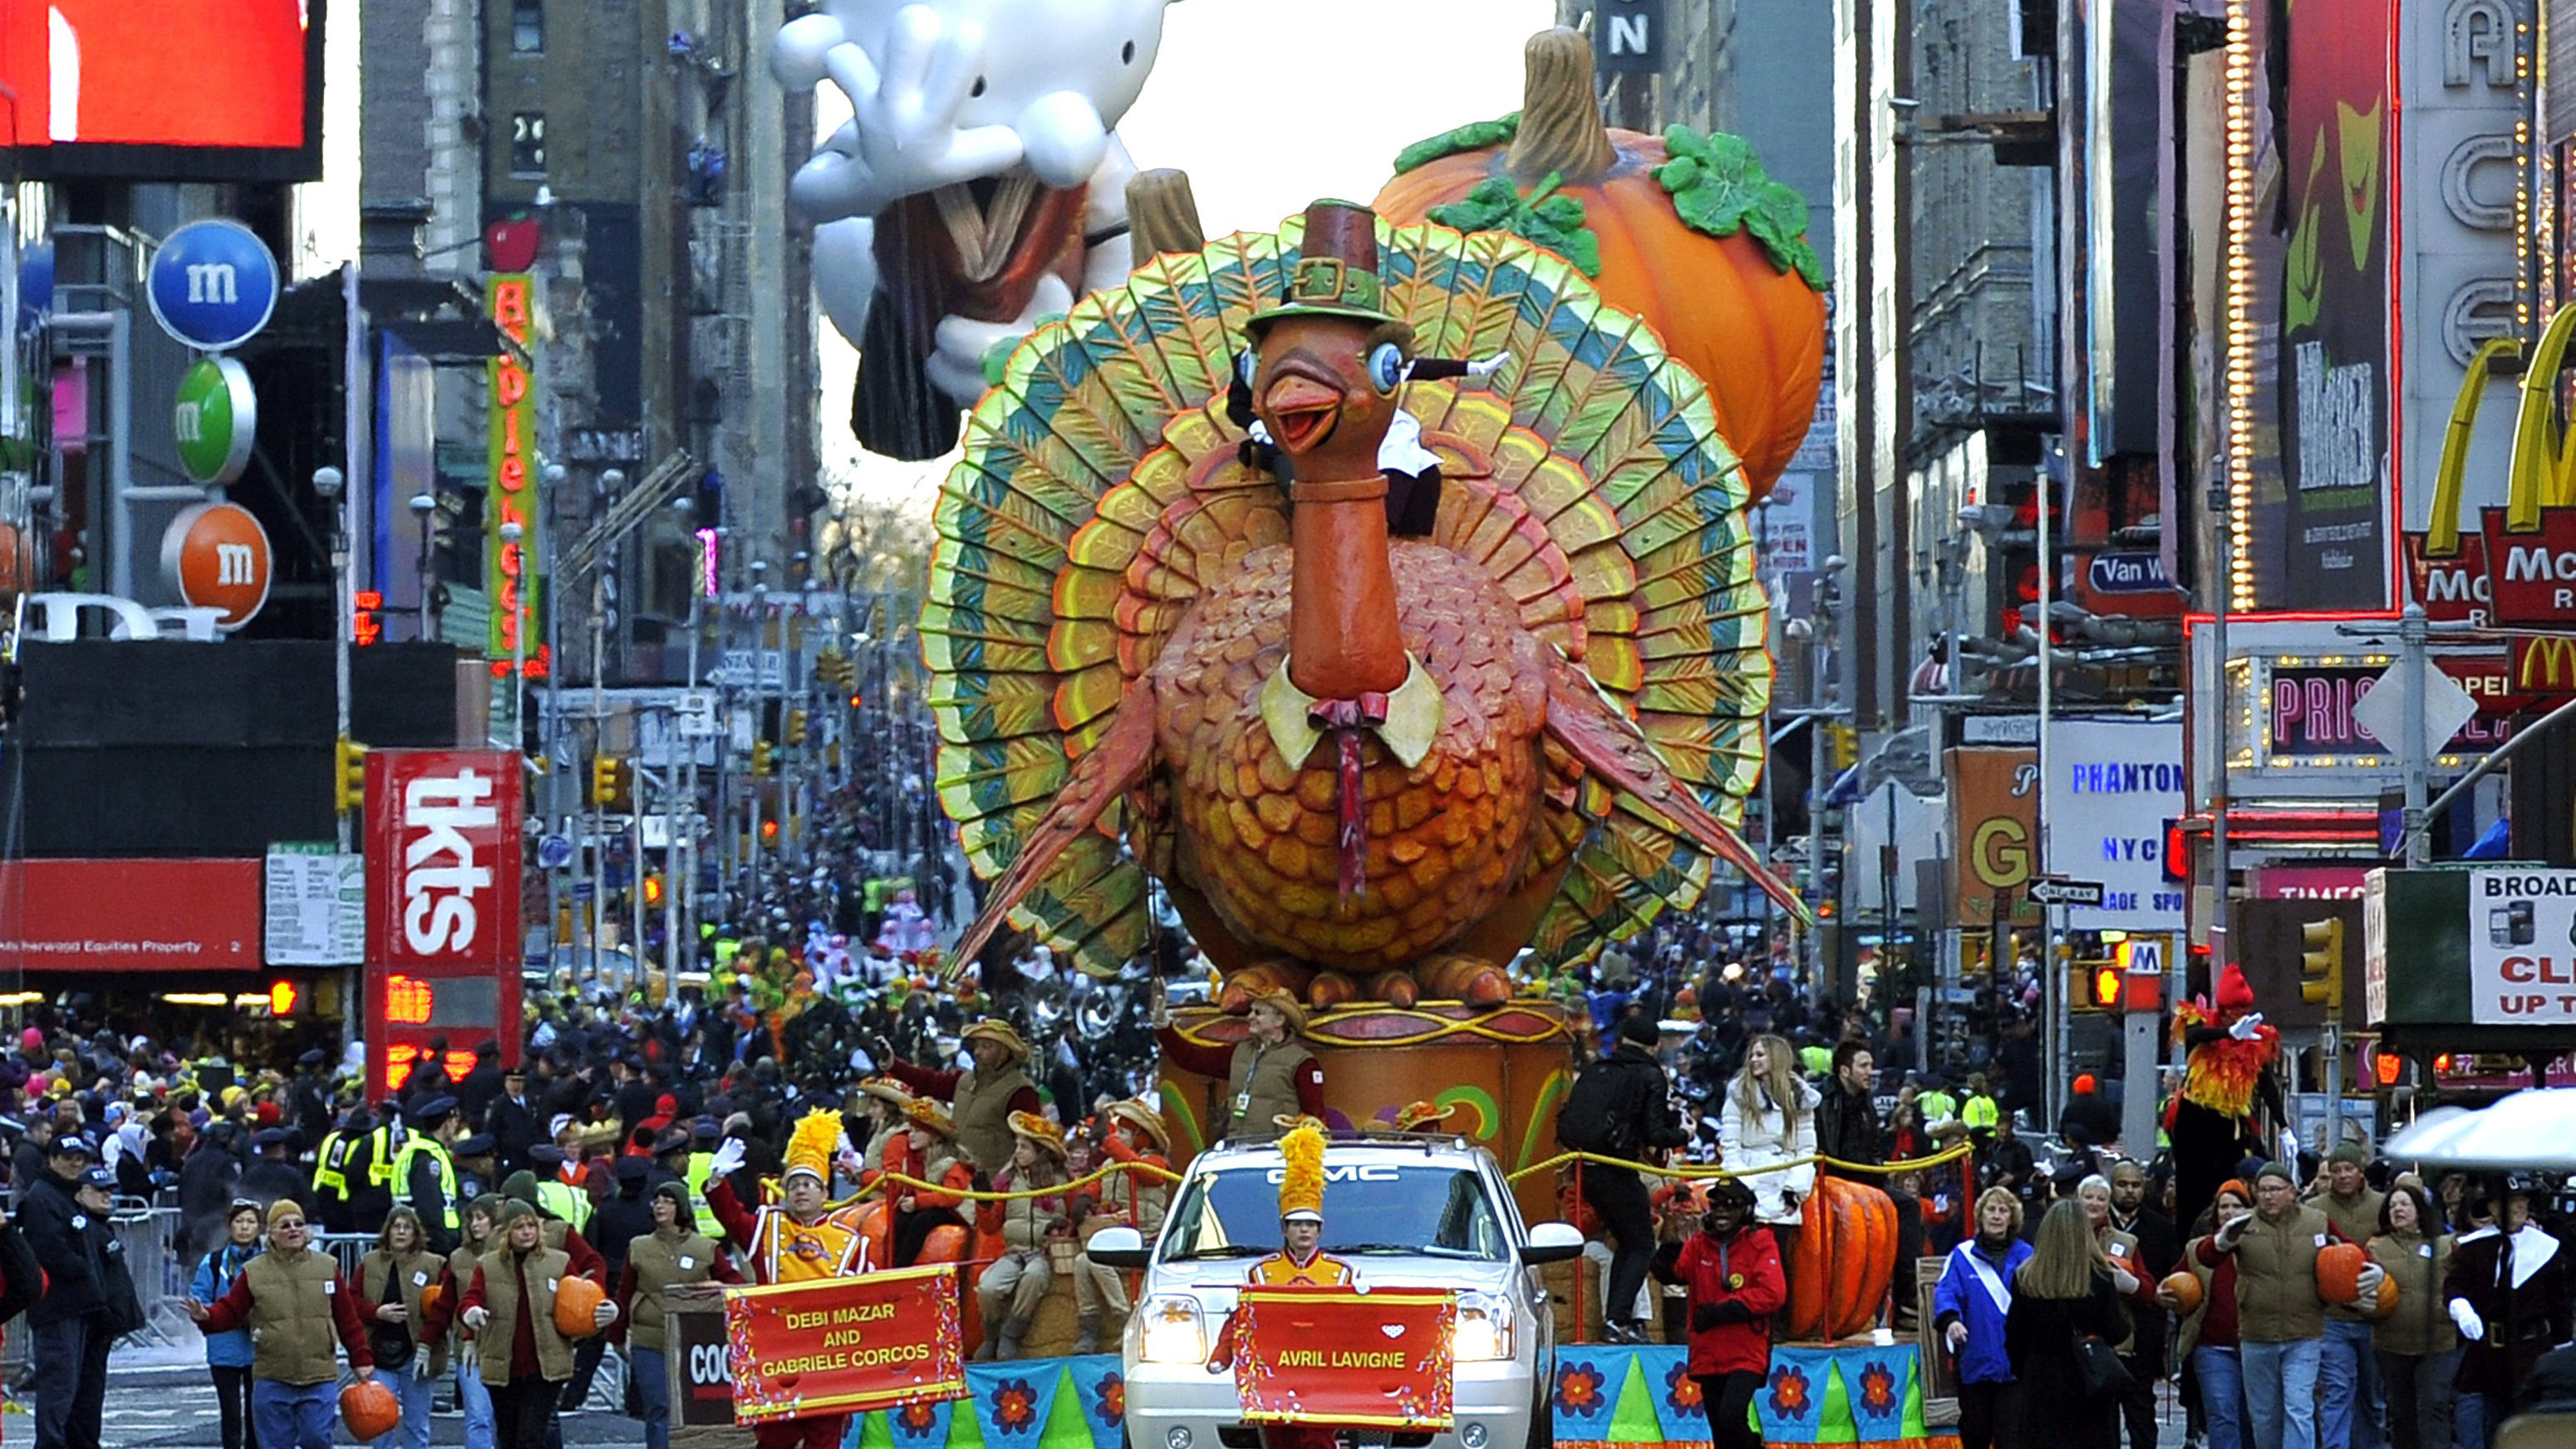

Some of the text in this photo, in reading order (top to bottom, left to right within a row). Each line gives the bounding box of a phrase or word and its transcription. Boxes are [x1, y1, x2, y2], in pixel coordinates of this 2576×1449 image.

[1609, 14, 1648, 55] N
[186, 263, 238, 304] m
[216, 543, 254, 586] m
[2102, 557, 2142, 582] Van
[405, 769, 498, 955] tkts
[1972, 816, 2030, 887] G
[2102, 837, 2158, 862] NYC
[2500, 955, 2576, 984] CL
[2500, 995, 2547, 1014] UP
[785, 1303, 895, 1329] DEBI MAZAR
[823, 1329, 861, 1348] AND
[761, 1343, 929, 1378] GABRIELE CORCOS
[1277, 1350, 1405, 1368] AVRIL LAVIGNE
